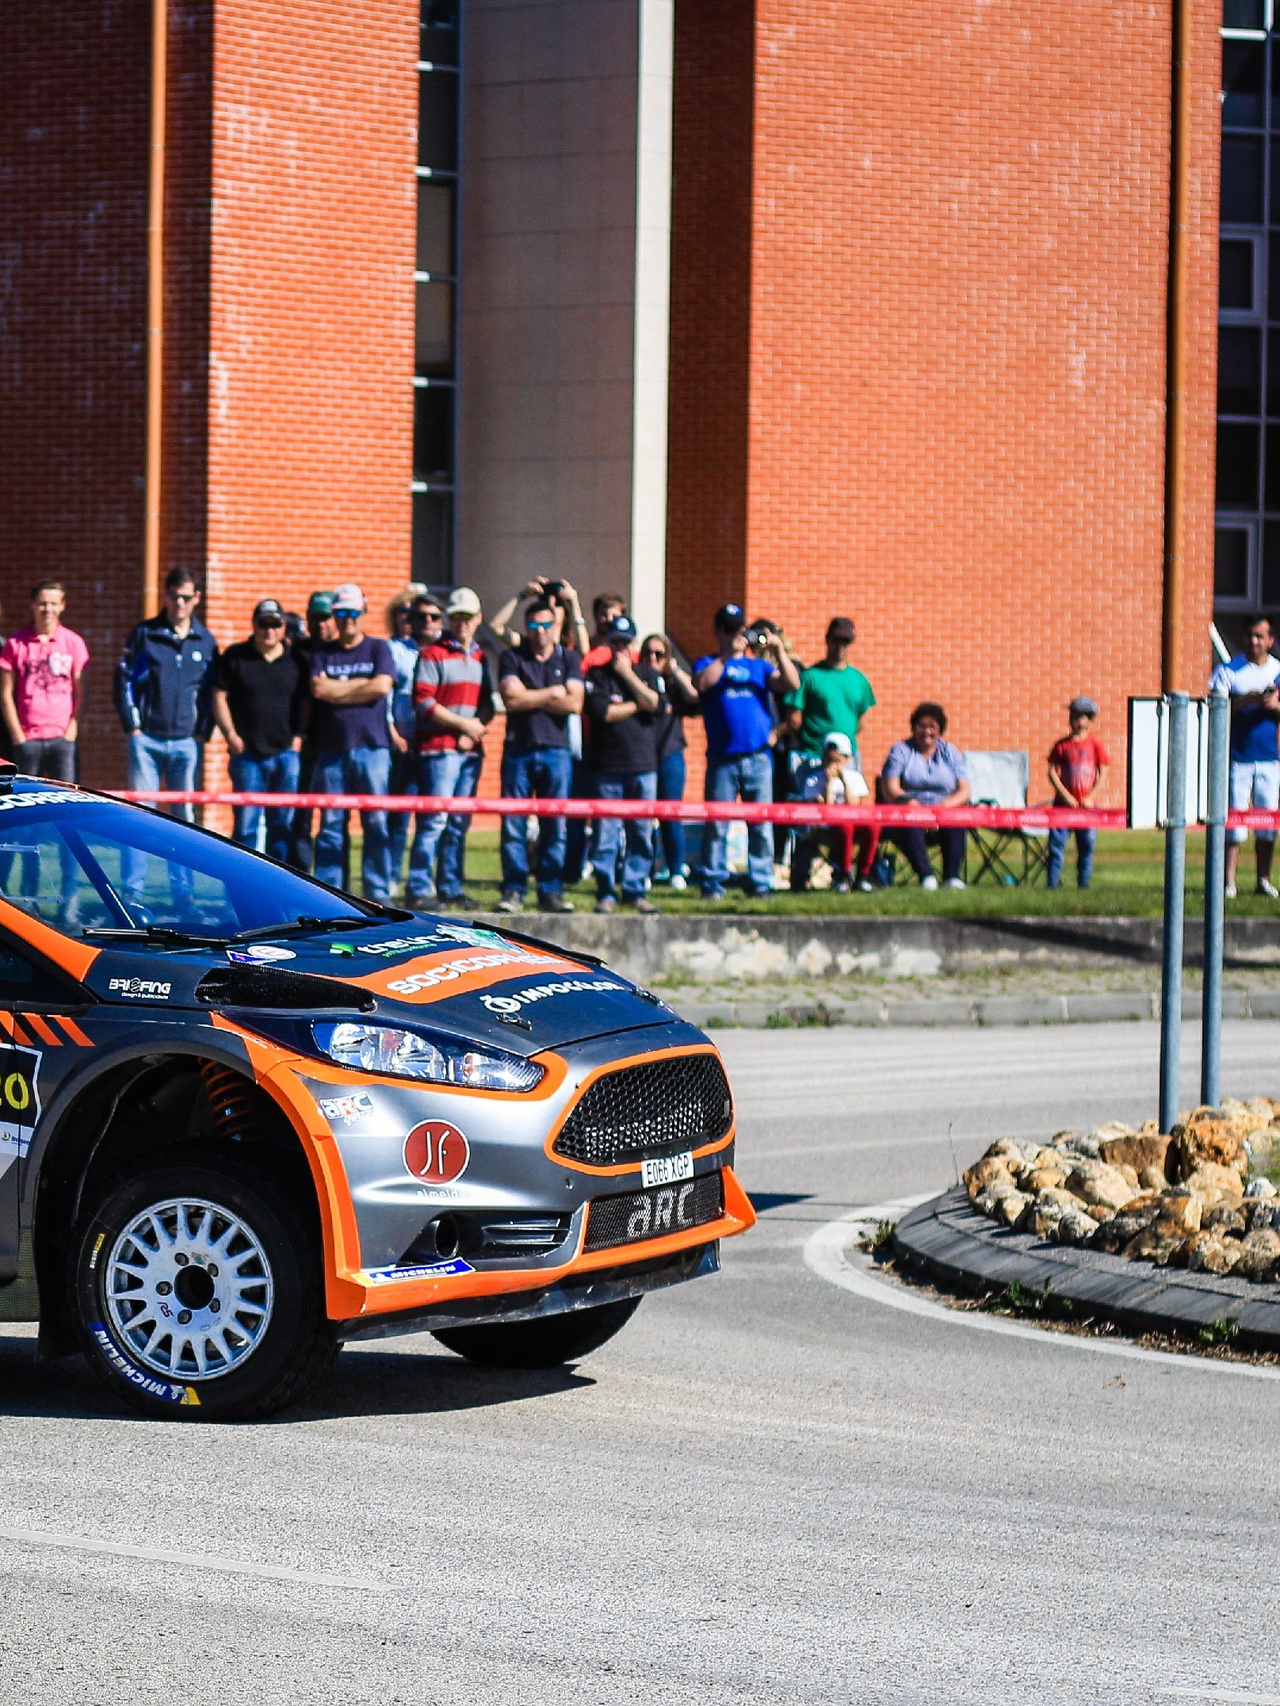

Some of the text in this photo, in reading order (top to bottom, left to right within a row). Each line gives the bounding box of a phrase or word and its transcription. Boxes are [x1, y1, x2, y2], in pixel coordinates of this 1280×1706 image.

[671, 1154, 689, 1179] XGP
[417, 1189, 466, 1199] almeid
[391, 1264, 456, 1279] MICHELIN
[94, 1329, 167, 1397] MICHELIN
